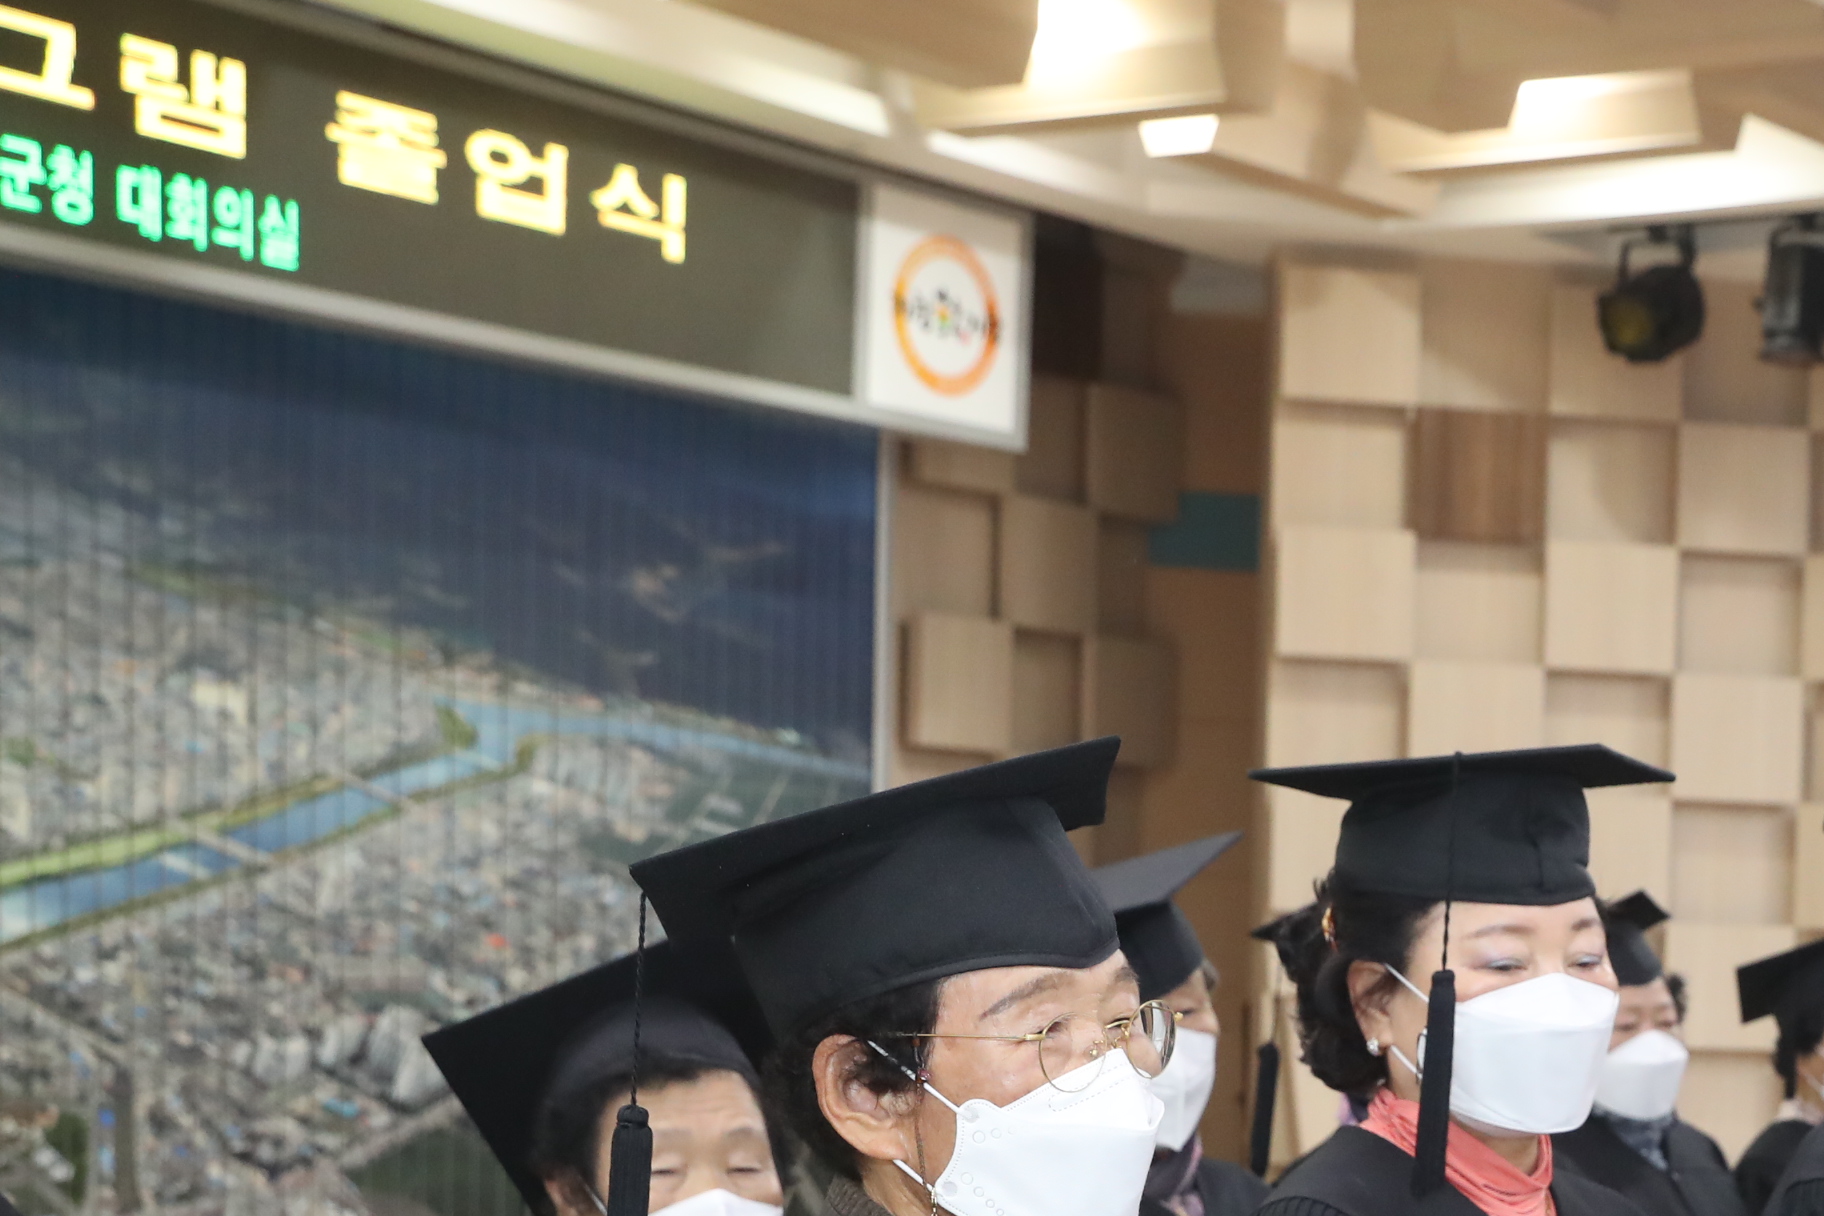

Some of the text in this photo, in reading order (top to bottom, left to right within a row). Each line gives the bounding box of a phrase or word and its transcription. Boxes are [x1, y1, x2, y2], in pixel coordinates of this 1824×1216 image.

[0, 133, 300, 272] 군청 대회의실
[325, 89, 687, 264] 졸업식
